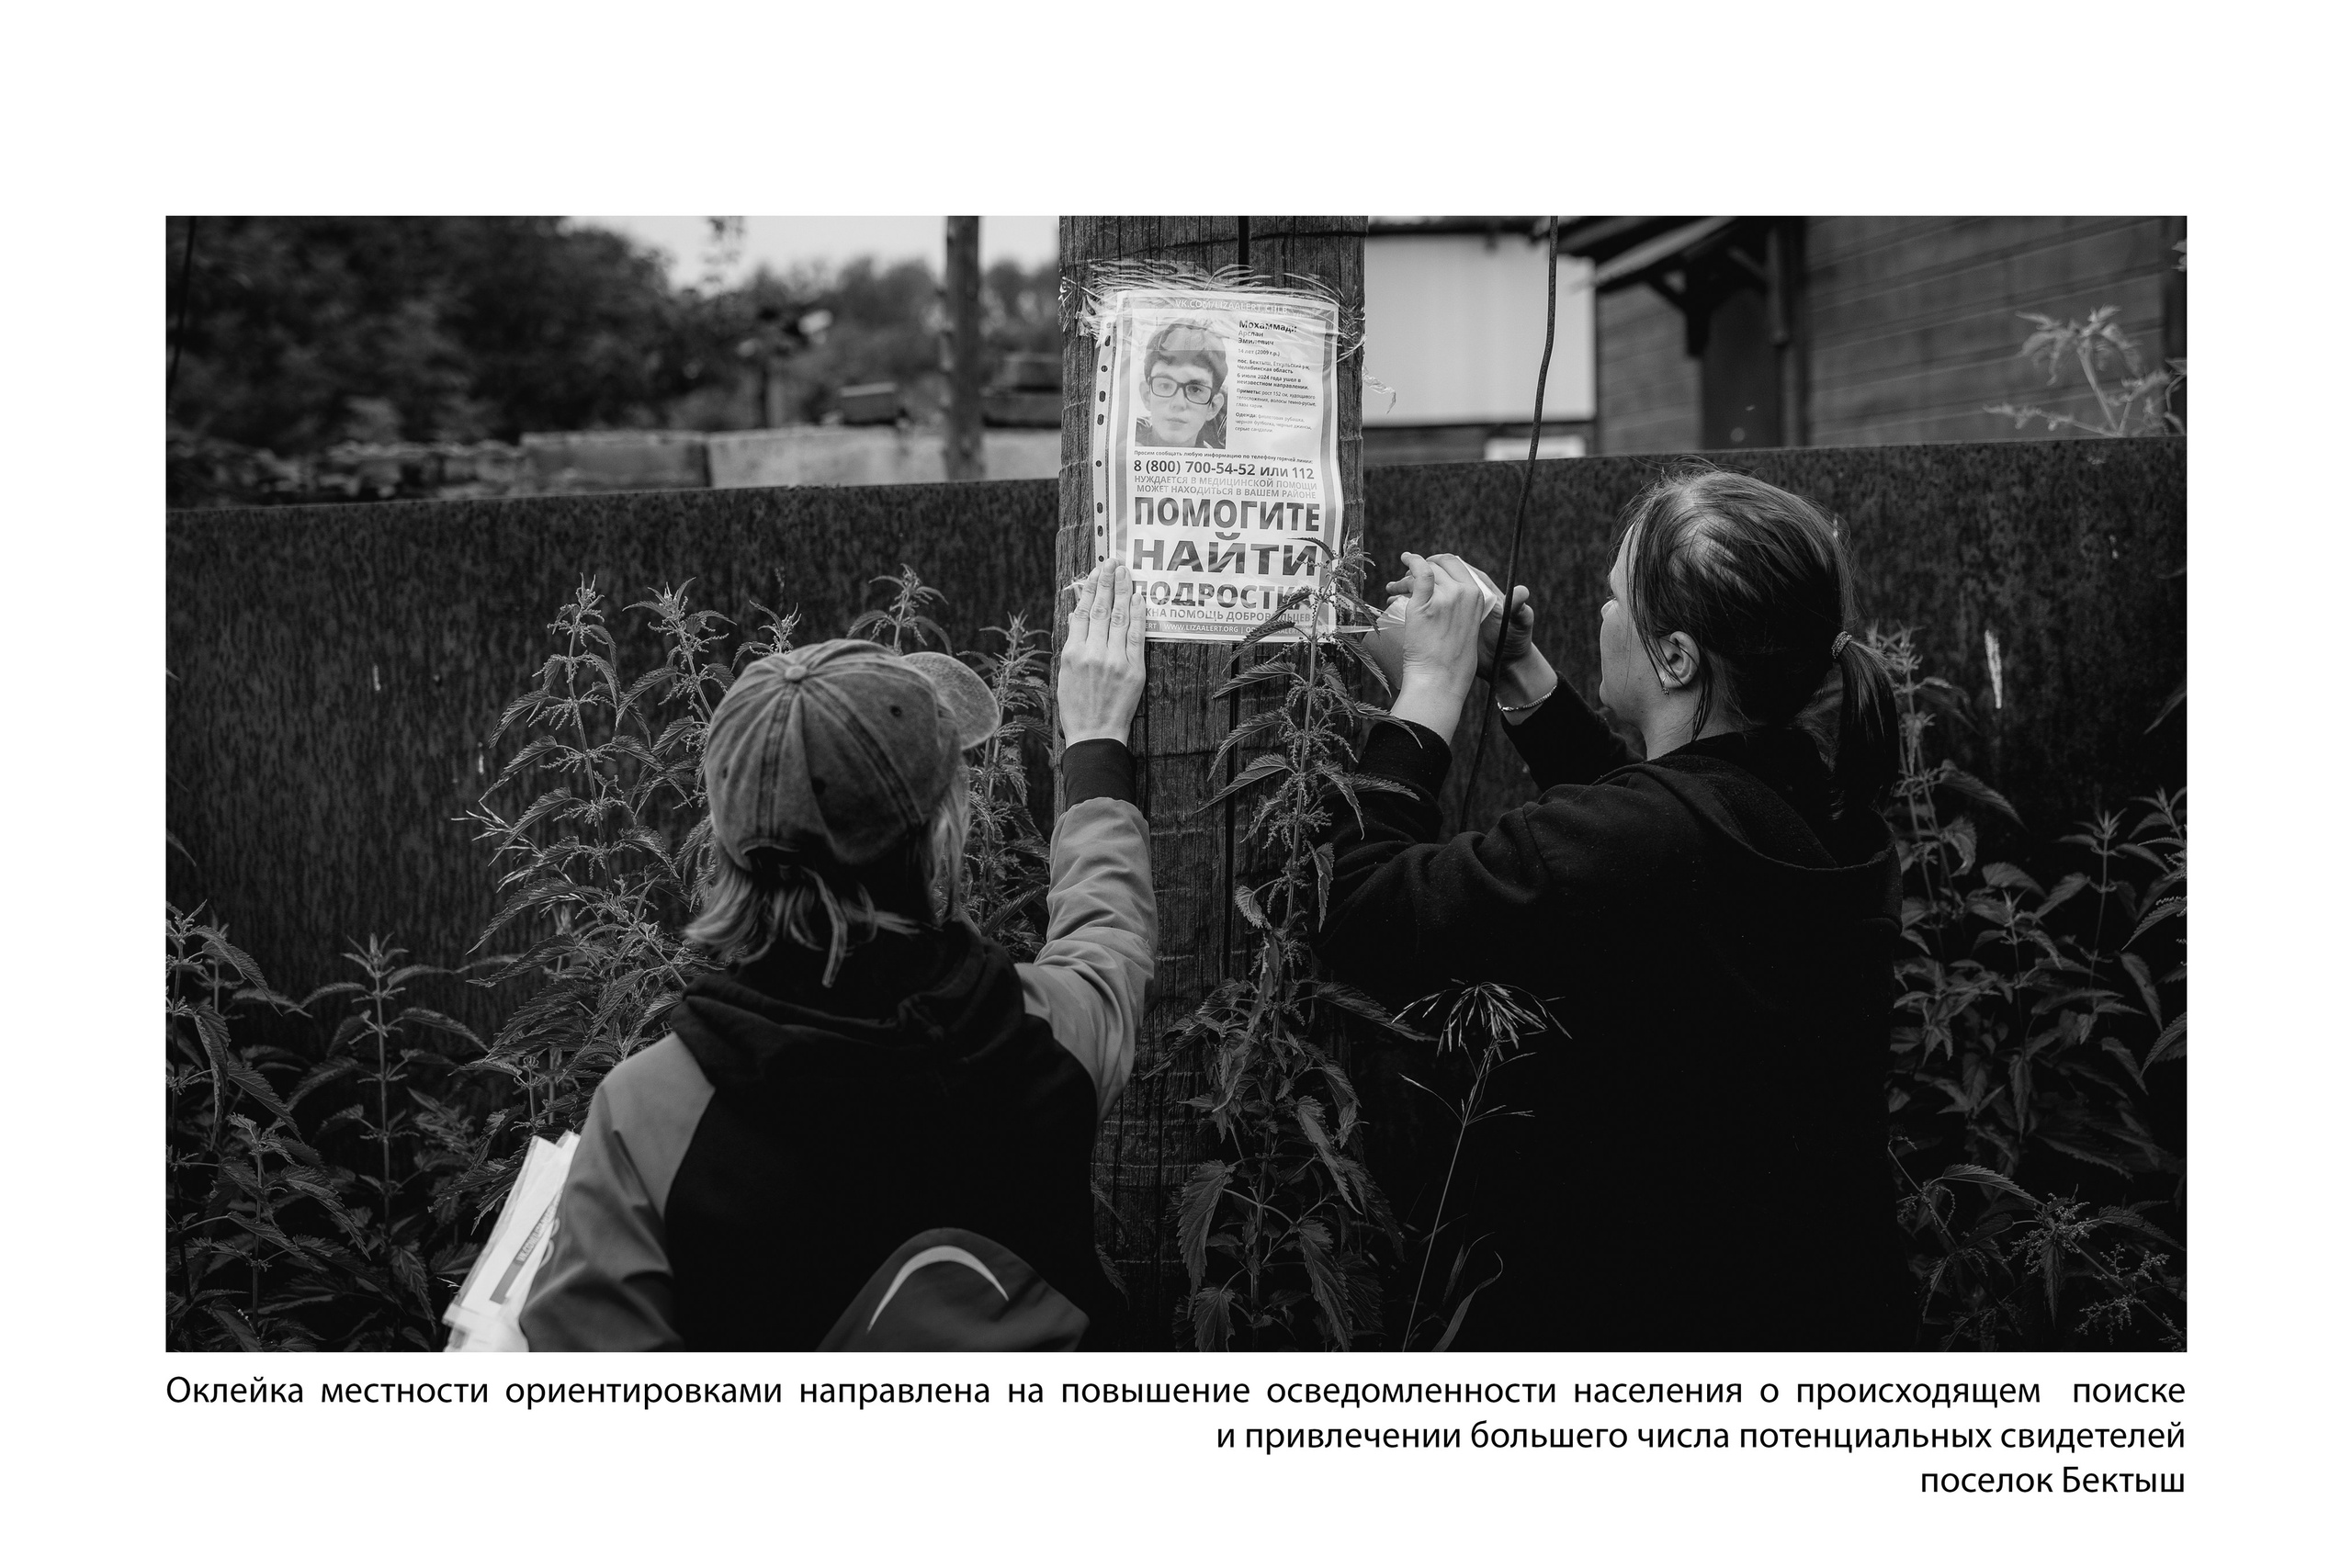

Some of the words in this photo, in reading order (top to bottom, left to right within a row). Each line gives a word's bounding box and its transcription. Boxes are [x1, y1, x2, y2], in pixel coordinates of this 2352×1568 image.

[1239, 321, 1297, 333] Мохаммади
[1134, 459, 1142, 472] 8
[1146, 459, 1181, 475] (800)
[1185, 460, 1256, 476] 700-54-52
[1260, 467, 1289, 478] или
[1292, 467, 1315, 479] 112
[1134, 475, 1188, 485] НУЖДАЕТСЯ
[1199, 477, 1273, 488] МЕДИЦИНСКОЙ
[1277, 479, 1317, 491] ПОМОЩИ
[1136, 485, 1169, 493] МОЖЕТ
[1170, 485, 1233, 496] НАХОДИТЬСЯ
[1236, 488, 1242, 496] В
[1244, 488, 1279, 497] ВАШЕМ
[1282, 488, 1317, 499] РАЙОНЕ
[1135, 496, 1320, 532] ПОМОГИТЕ
[1133, 531, 1317, 577] НАЙТИ
[1170, 608, 1224, 623] ПОМОЩЬ
[1226, 611, 1311, 625] ДОБРОВЛЬЦЕВ
[1164, 623, 1238, 634] WWW.LIZAALERT.ORG
